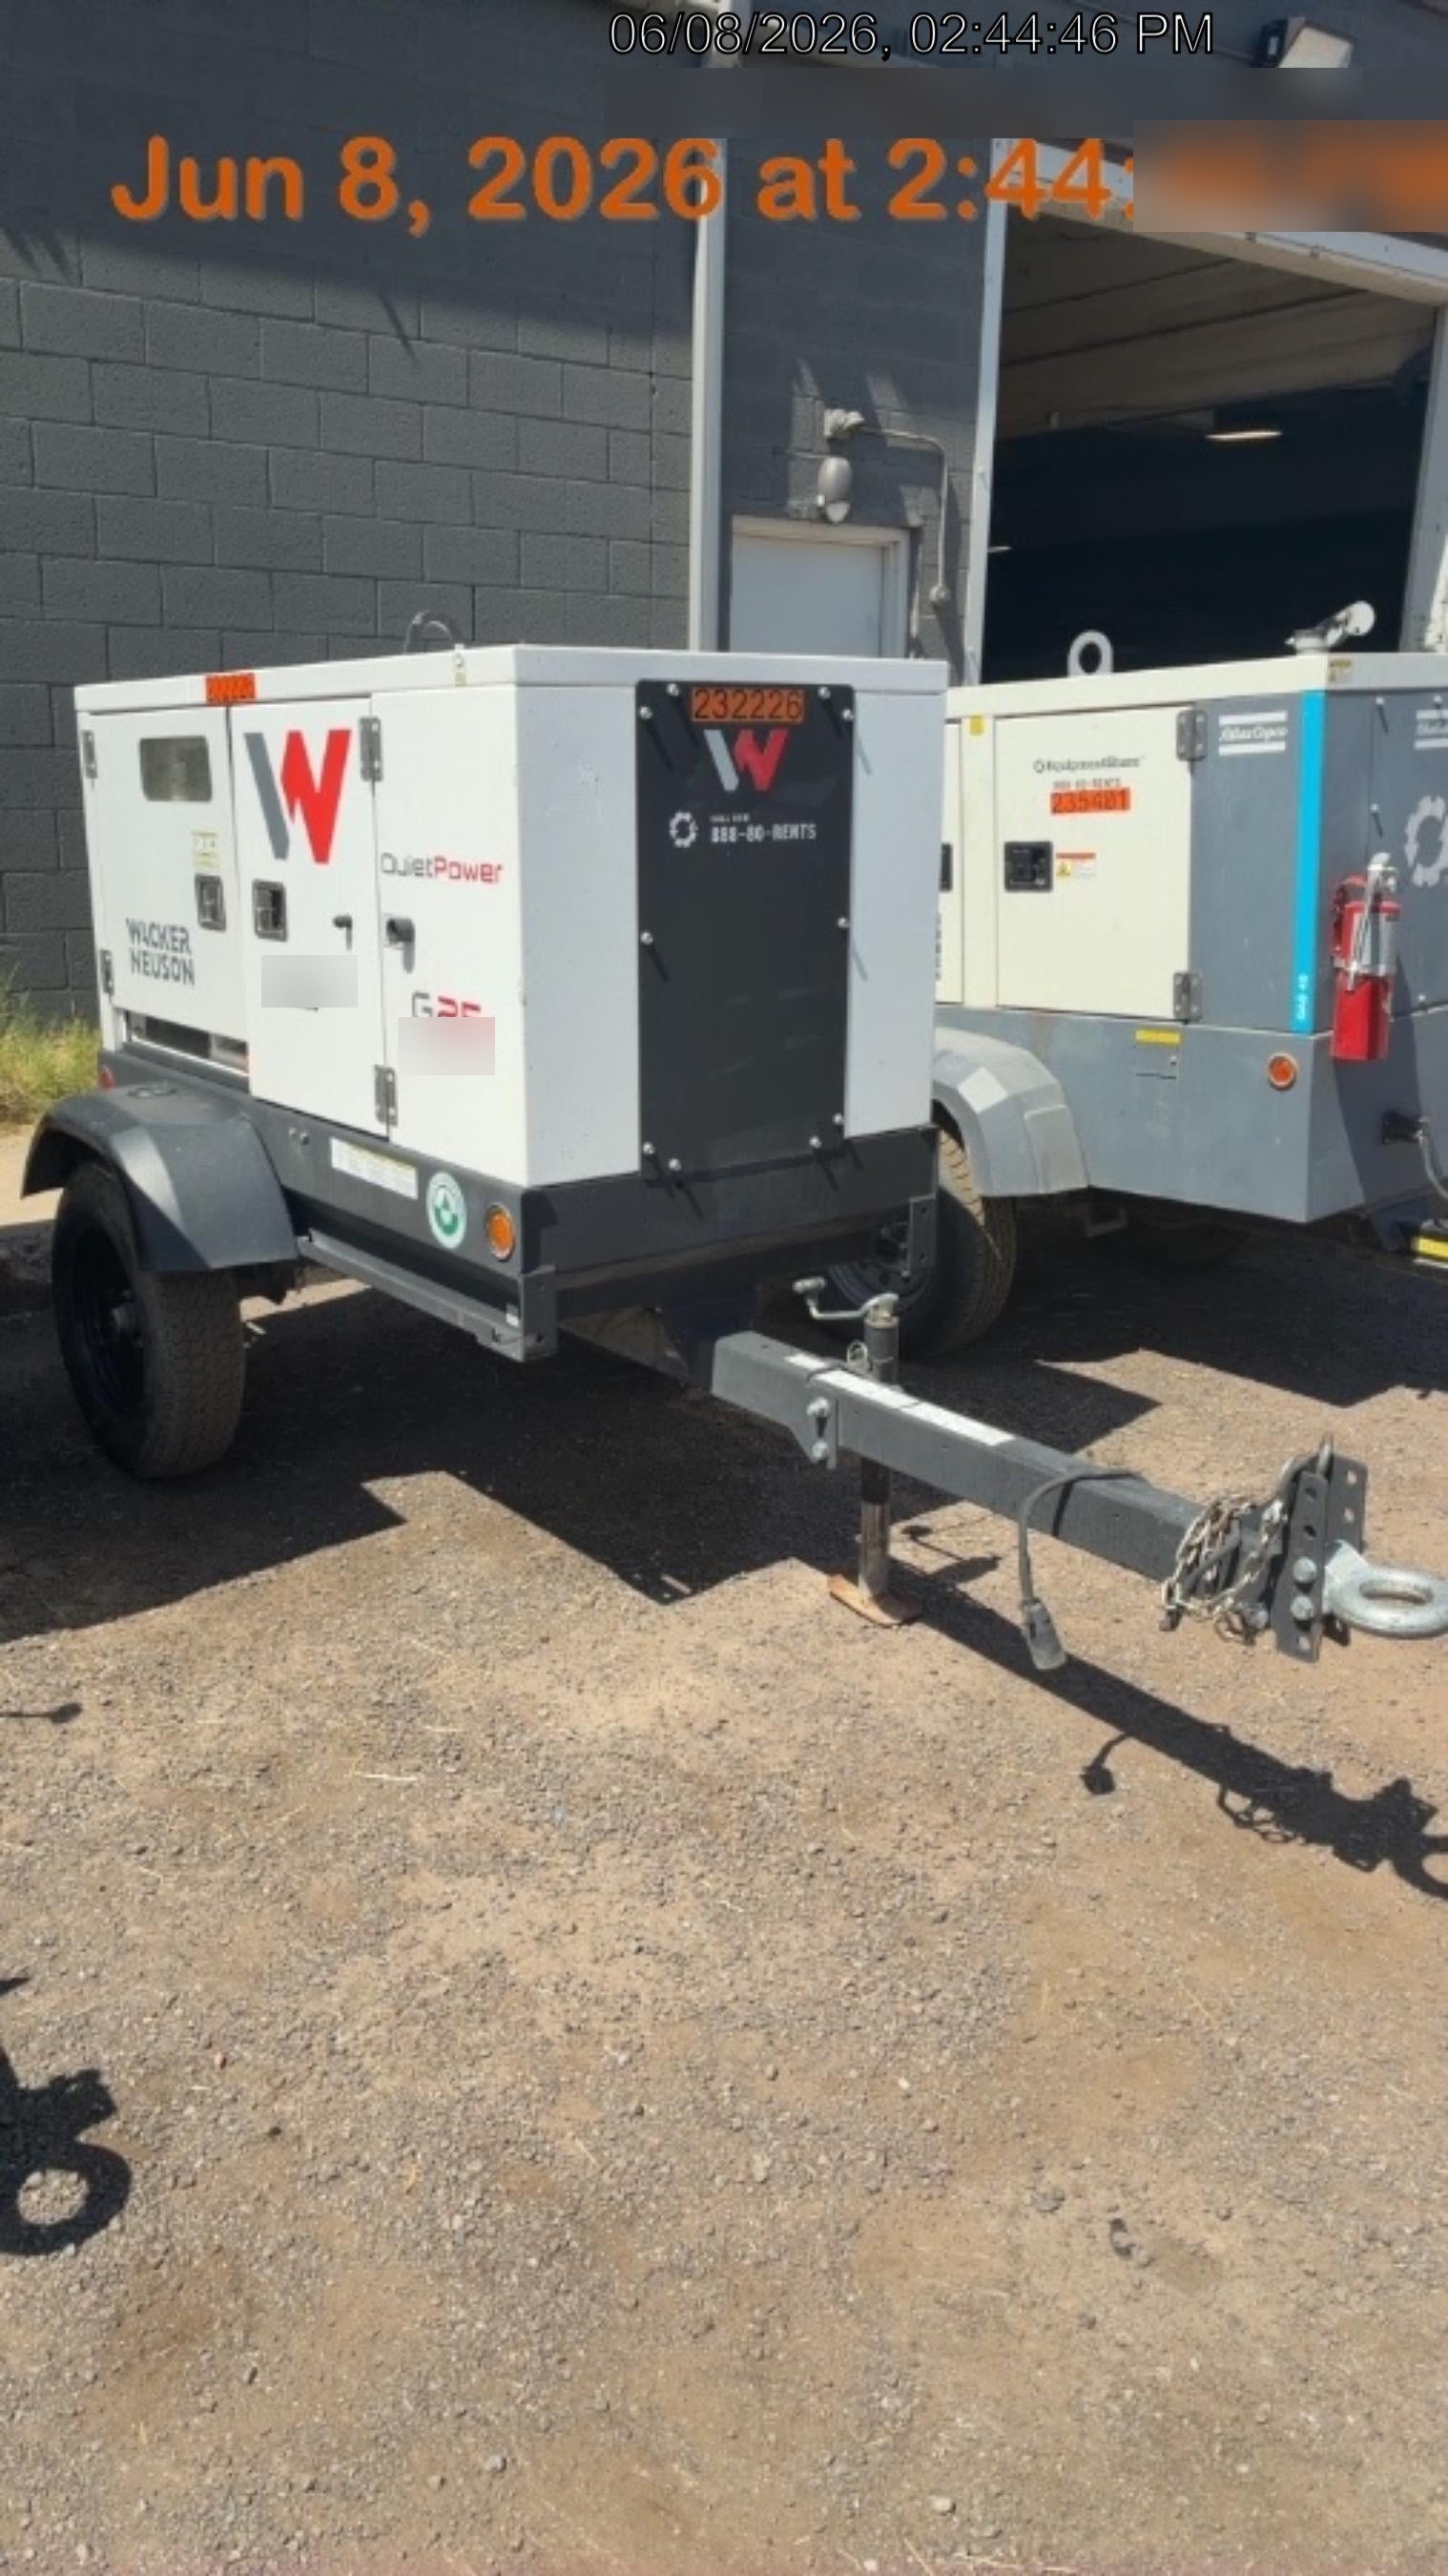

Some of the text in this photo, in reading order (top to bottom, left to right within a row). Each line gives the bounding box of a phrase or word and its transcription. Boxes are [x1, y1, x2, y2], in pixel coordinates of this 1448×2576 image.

[694, 688, 803, 719] 232226
[381, 852, 504, 884] QuietPower
[125, 918, 192, 956] WACKER
[130, 947, 196, 987] NEUSON
